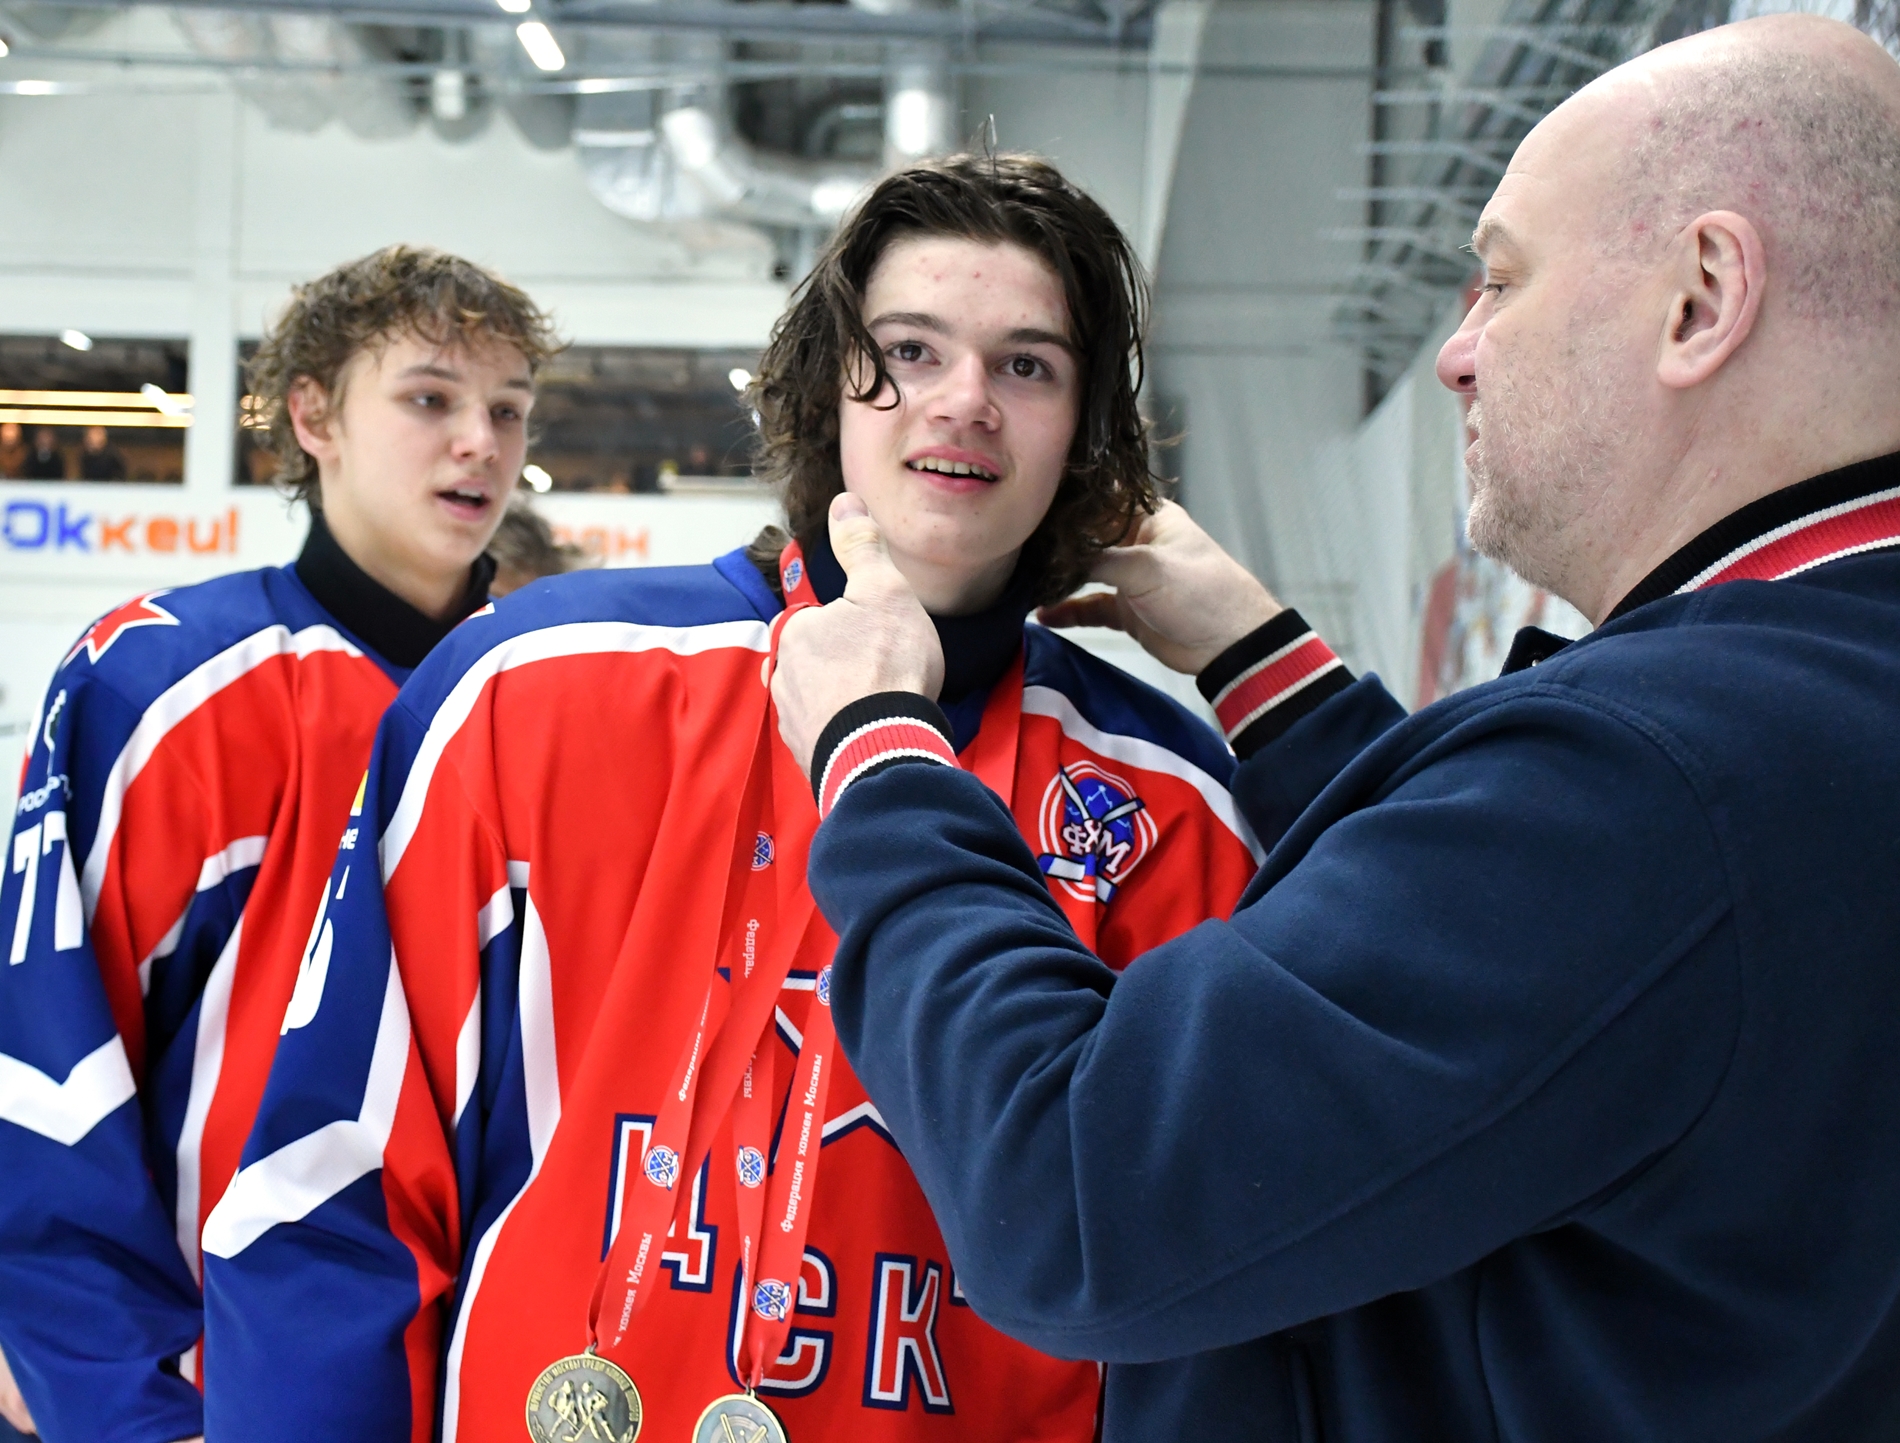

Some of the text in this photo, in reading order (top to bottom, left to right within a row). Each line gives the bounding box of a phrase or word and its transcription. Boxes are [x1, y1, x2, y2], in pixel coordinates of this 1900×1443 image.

[9, 810, 84, 967] 77
[780, 1053, 823, 1234] Федерация хоккея Москвы
[601, 1112, 970, 1416] ЦСК
[619, 1231, 653, 1332] хоккея Москвы
